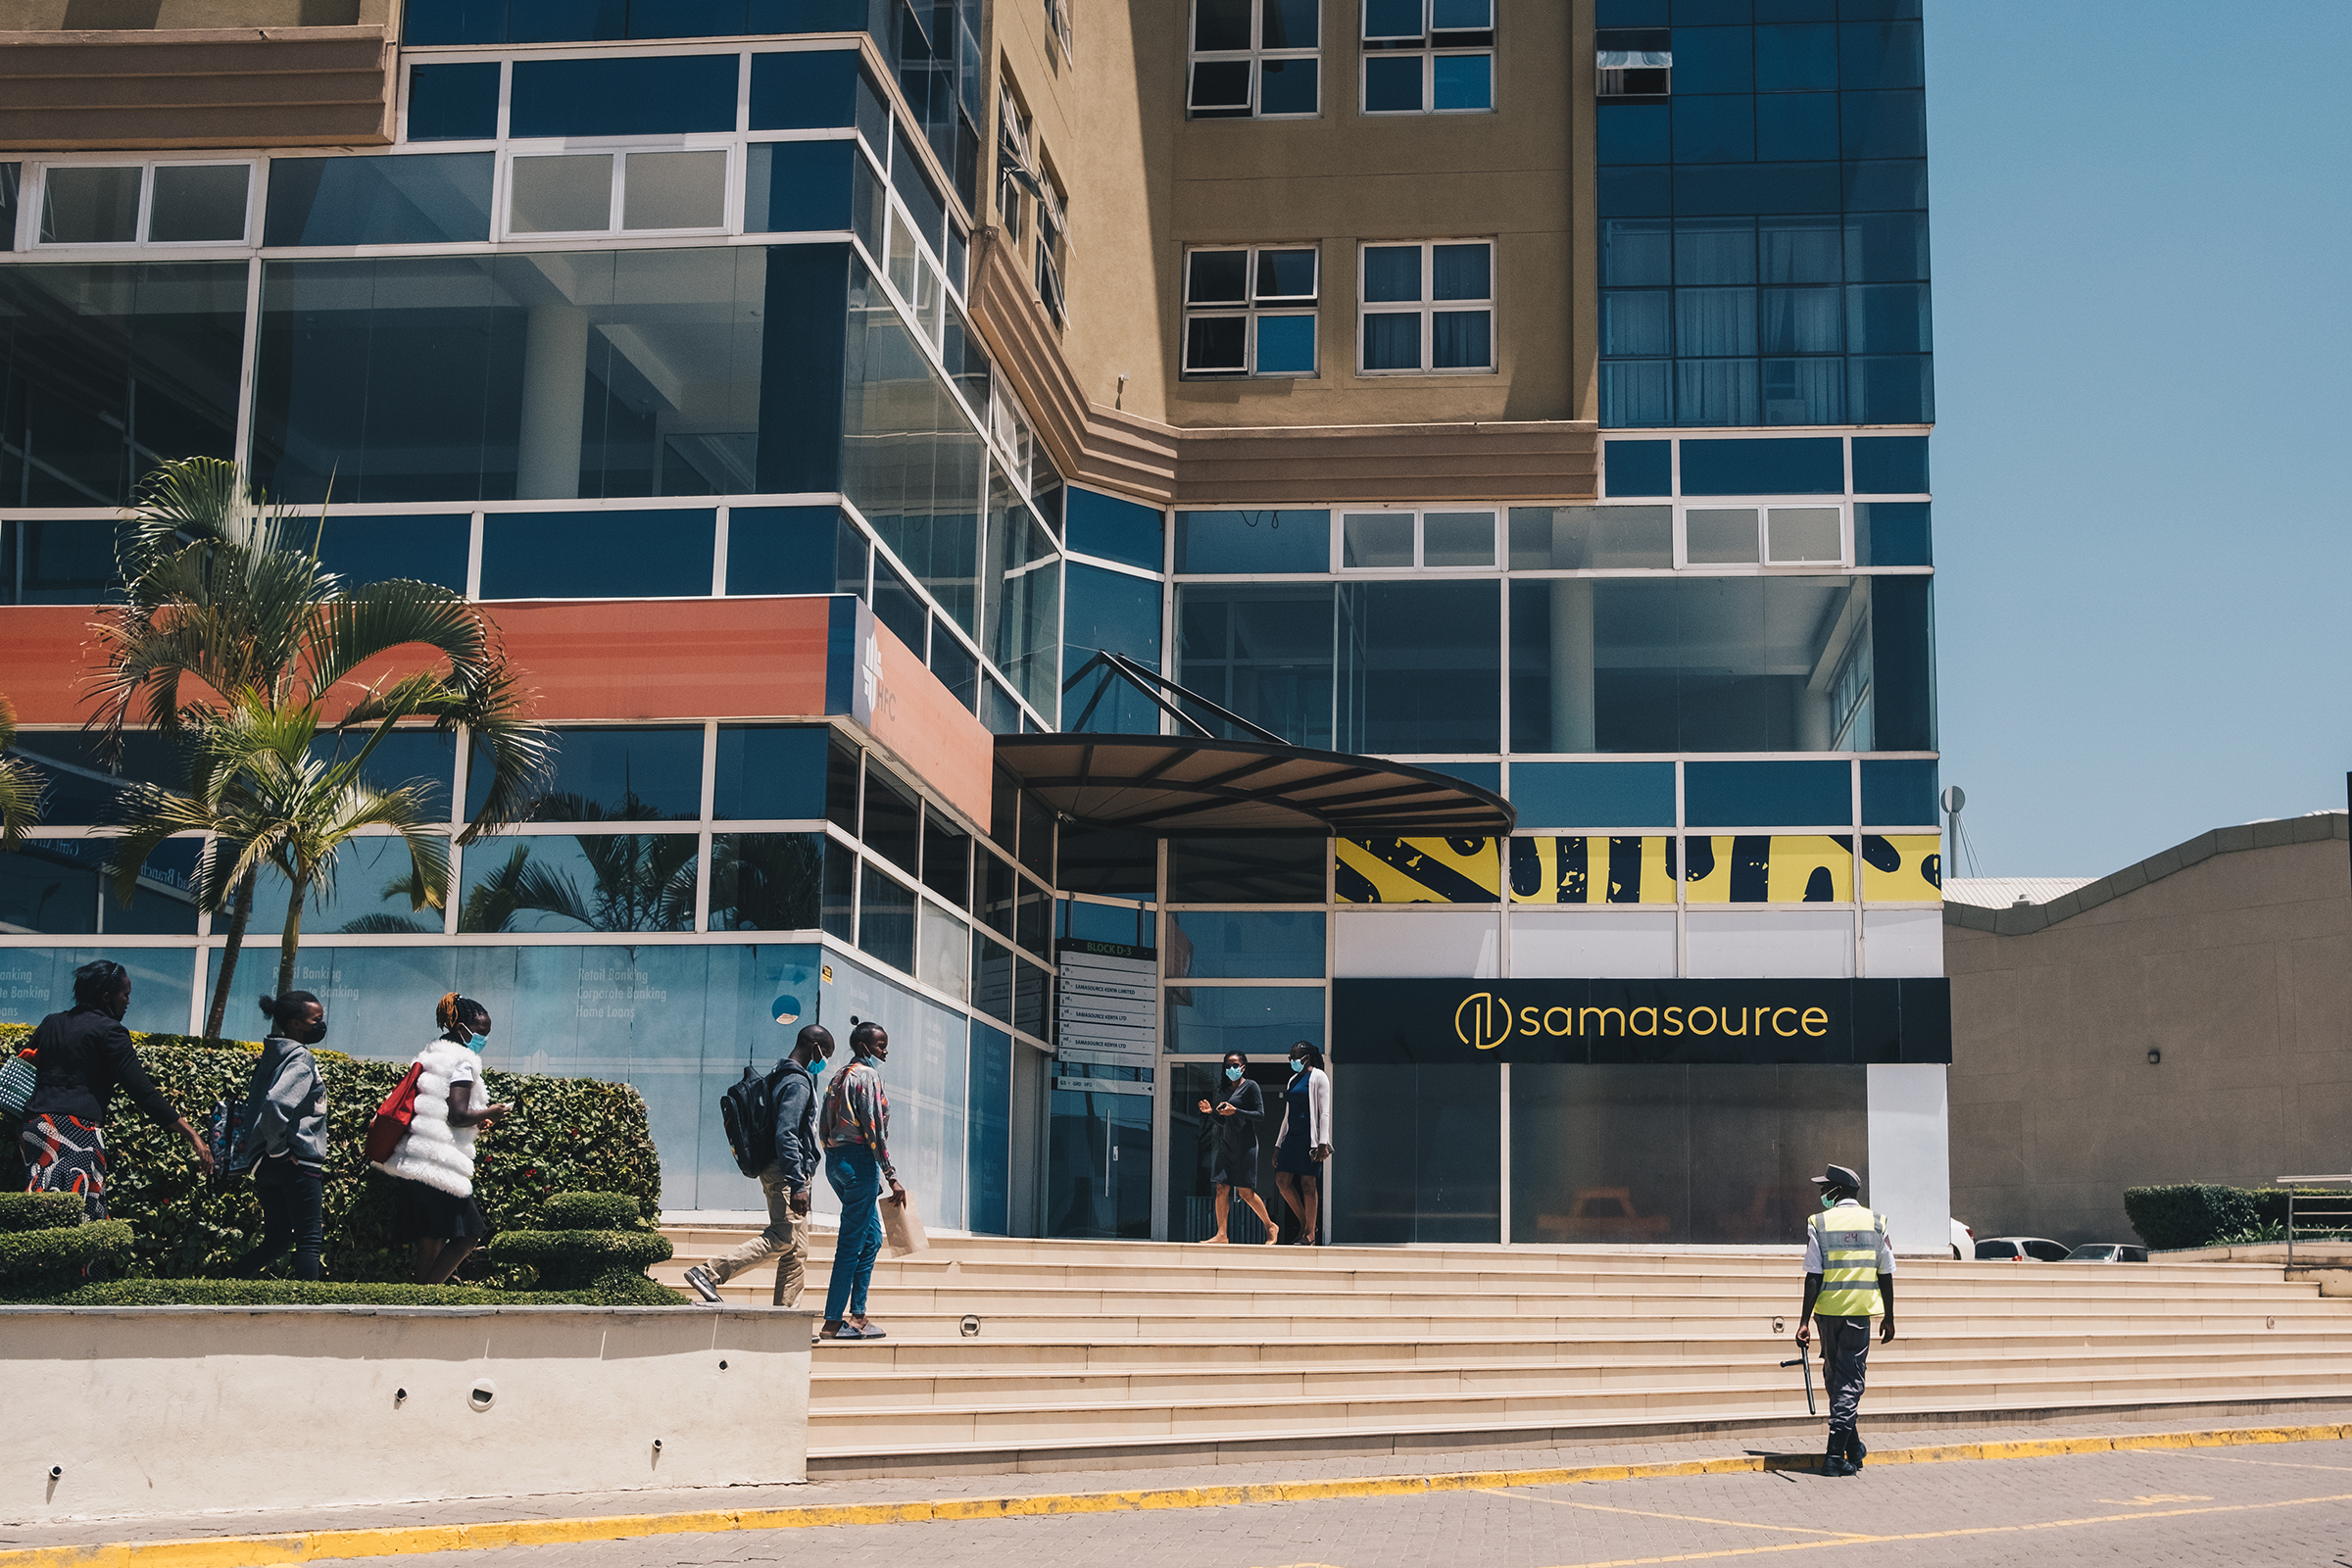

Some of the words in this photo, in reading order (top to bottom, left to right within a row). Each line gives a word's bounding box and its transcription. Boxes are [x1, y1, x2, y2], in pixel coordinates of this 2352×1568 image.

[877, 679, 897, 722] HFC
[1087, 942, 1115, 955] BLOCK
[1117, 946, 1132, 956] D-3
[0, 966, 32, 983] anking
[272, 966, 300, 979] Ril
[578, 967, 605, 981] Retail
[609, 967, 648, 984] Banking
[11, 985, 50, 1001] Banking
[320, 984, 360, 1001] Banking
[577, 986, 623, 1002] Corporate
[627, 986, 666, 1003] Banking
[1075, 984, 1103, 993] SAMASOURCE
[0, 1006, 18, 1016] ans
[576, 1004, 604, 1017] Home
[608, 1004, 635, 1018] Loans
[1520, 1006, 1829, 1037] samasource
[1844, 1232, 1858, 1243] 24
